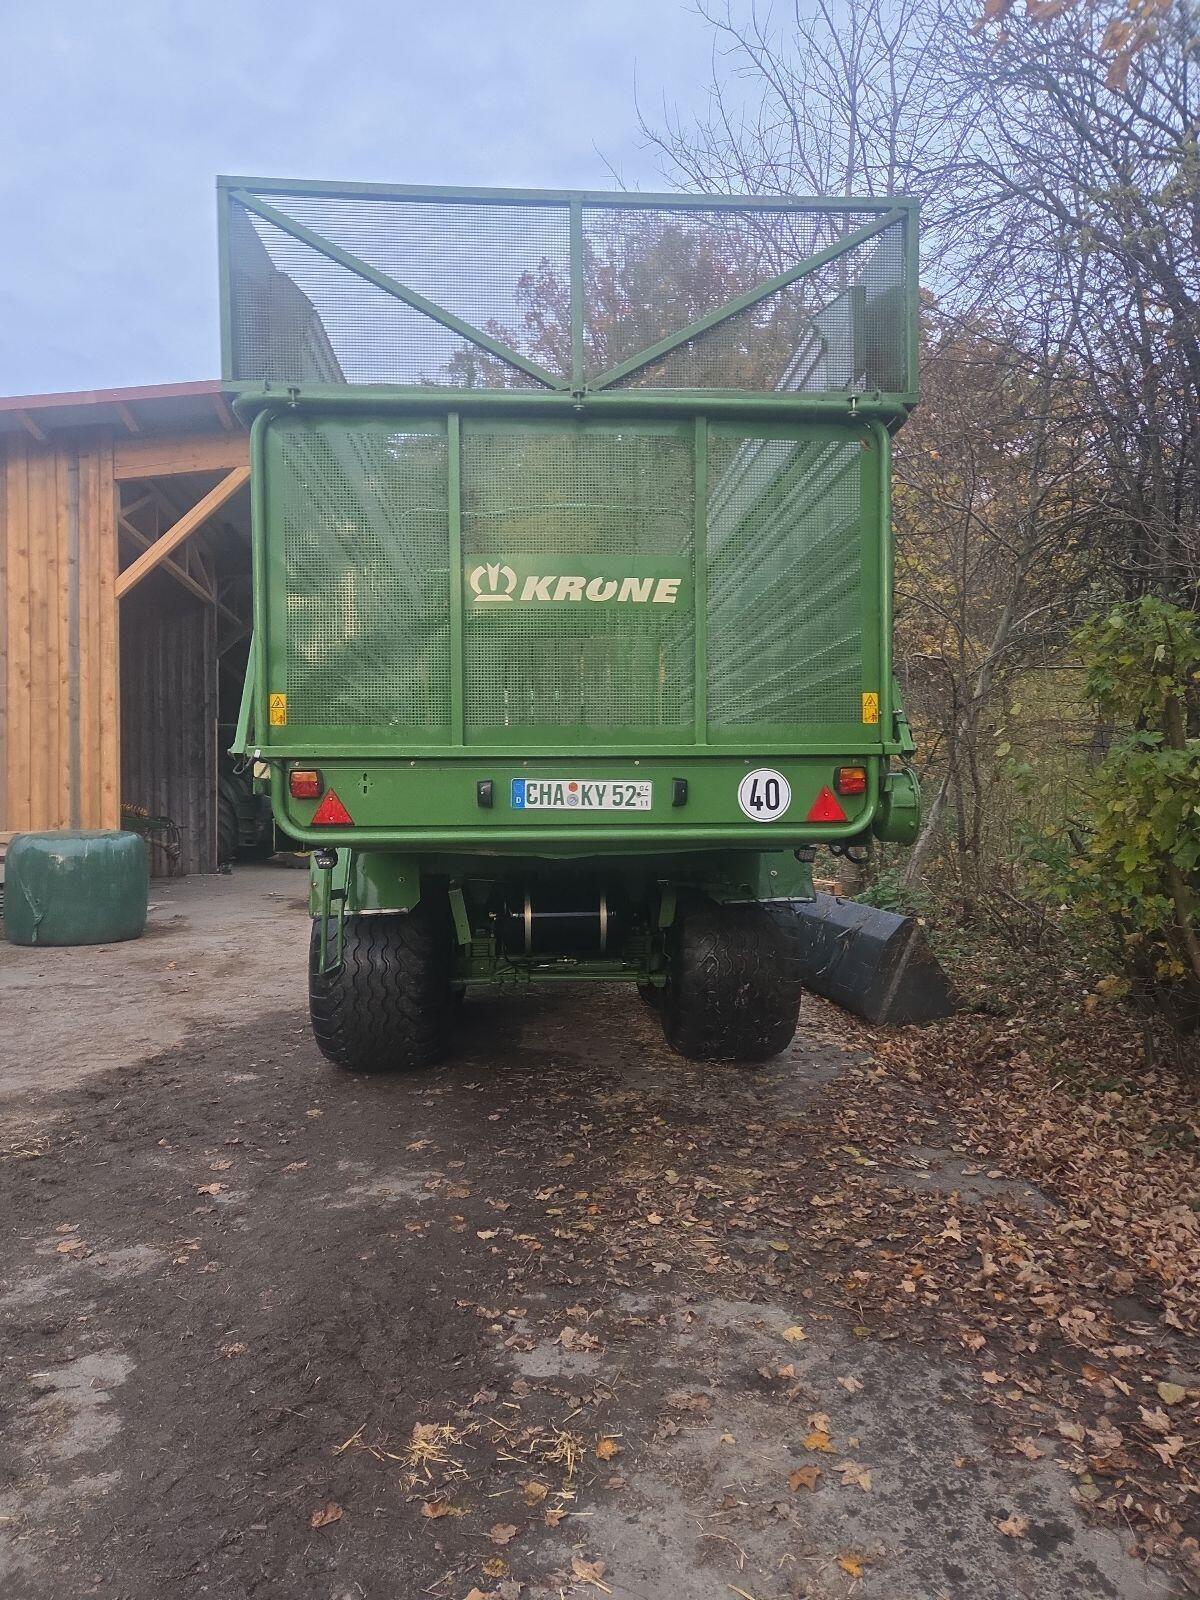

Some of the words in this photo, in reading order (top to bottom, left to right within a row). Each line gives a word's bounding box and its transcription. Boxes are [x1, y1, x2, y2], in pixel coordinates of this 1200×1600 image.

[520, 576, 682, 603] KRONE
[515, 796, 522, 804] D
[526, 783, 565, 805] CHA
[581, 784, 607, 806] KY
[612, 784, 637, 807] 52
[749, 778, 780, 811] 40
